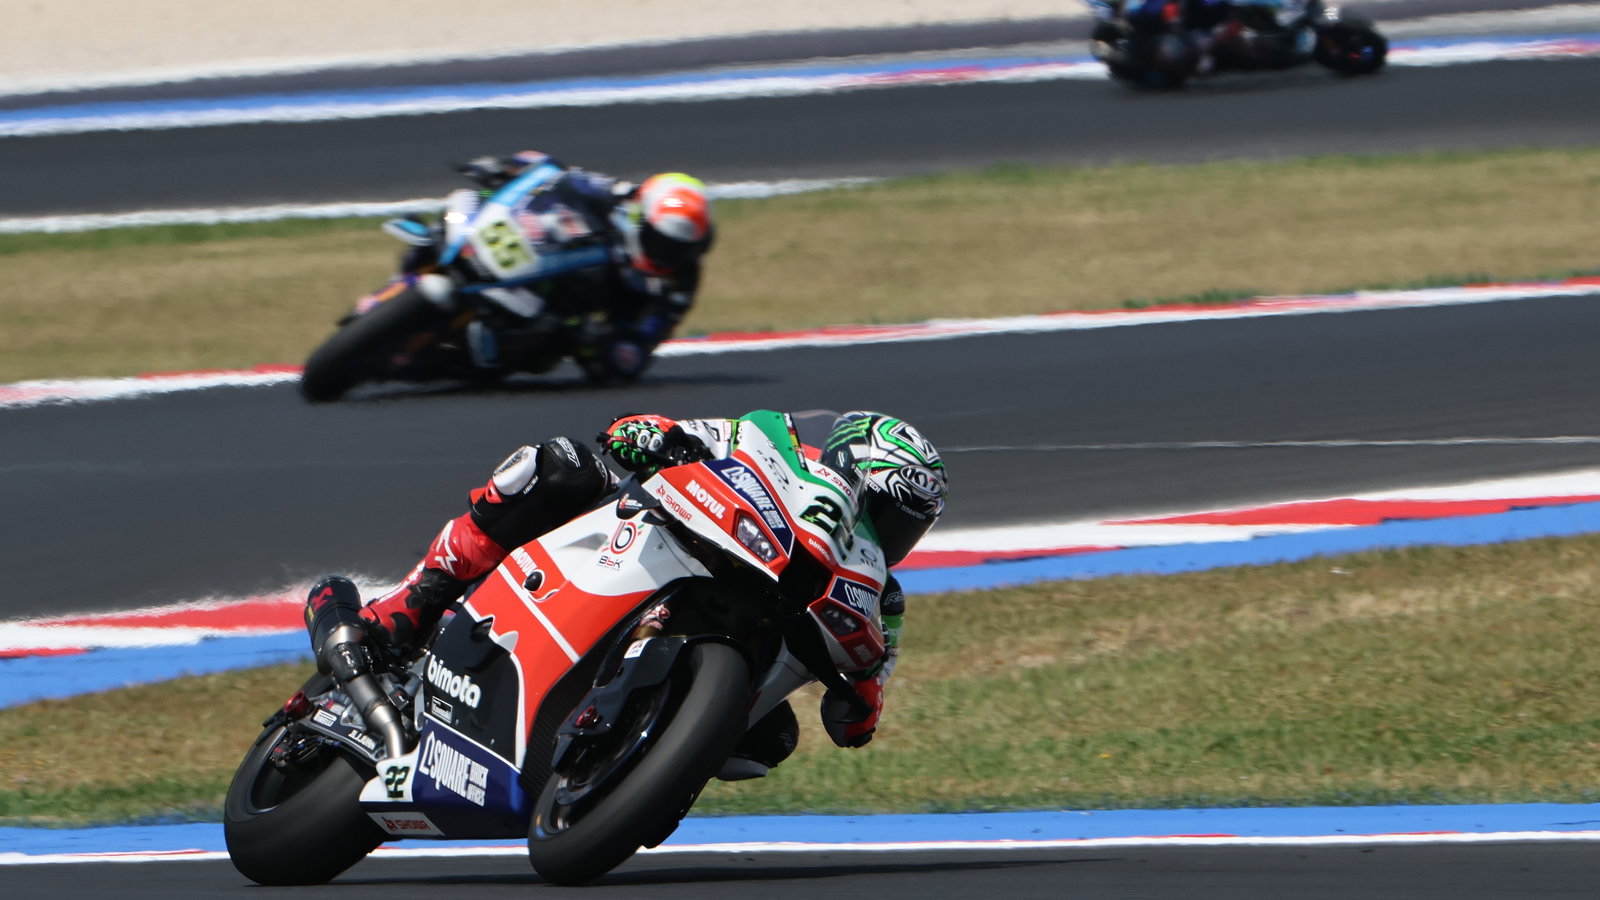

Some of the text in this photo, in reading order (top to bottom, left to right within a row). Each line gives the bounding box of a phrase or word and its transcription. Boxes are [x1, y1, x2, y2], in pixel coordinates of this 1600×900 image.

[664, 496, 693, 521] SHOWA
[684, 479, 727, 520] MOTUL
[733, 472, 776, 512] SQUARE
[427, 654, 482, 709] bimota
[386, 765, 410, 799] 22
[429, 740, 472, 798] SQUARE
